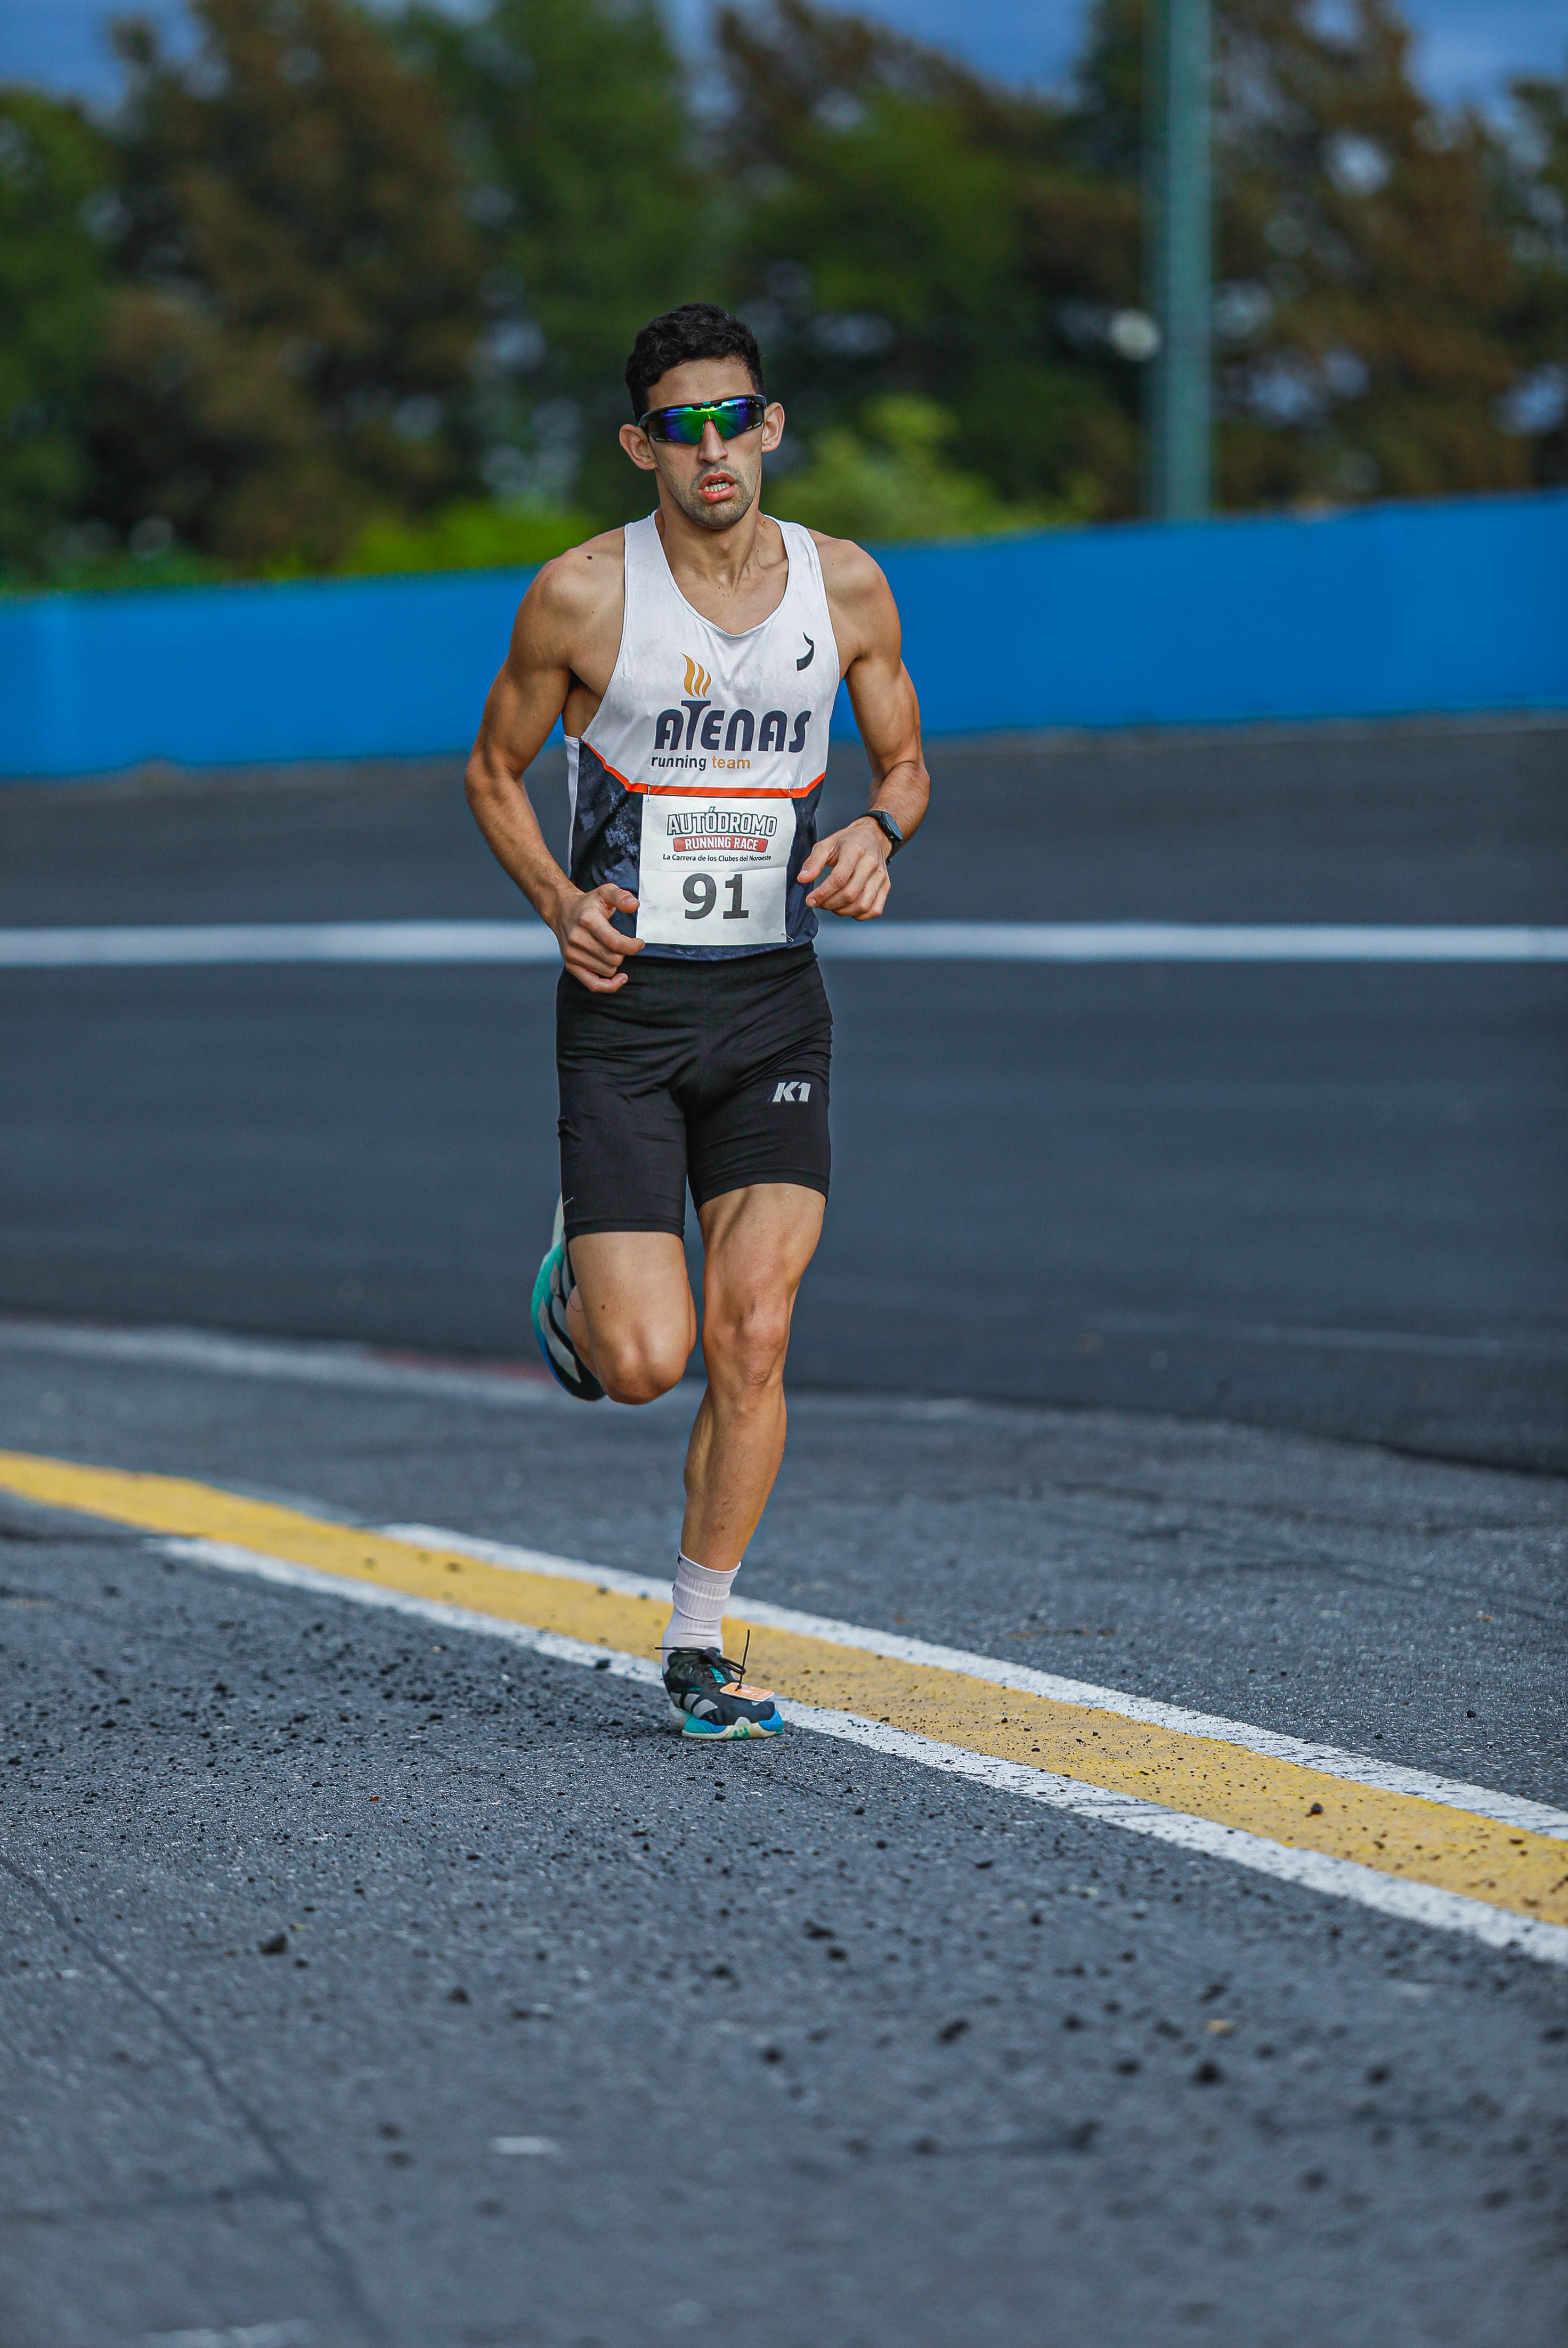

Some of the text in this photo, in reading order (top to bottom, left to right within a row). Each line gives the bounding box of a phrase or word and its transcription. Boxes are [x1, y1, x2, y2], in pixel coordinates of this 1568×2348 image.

[654, 700, 812, 753] ATENAS
[651, 754, 751, 771] running team
[667, 806, 777, 836] AUTÓDROMO
[684, 836, 759, 851] RUNNING RACE
[683, 873, 749, 920] 91
[773, 1081, 811, 1102] K1
